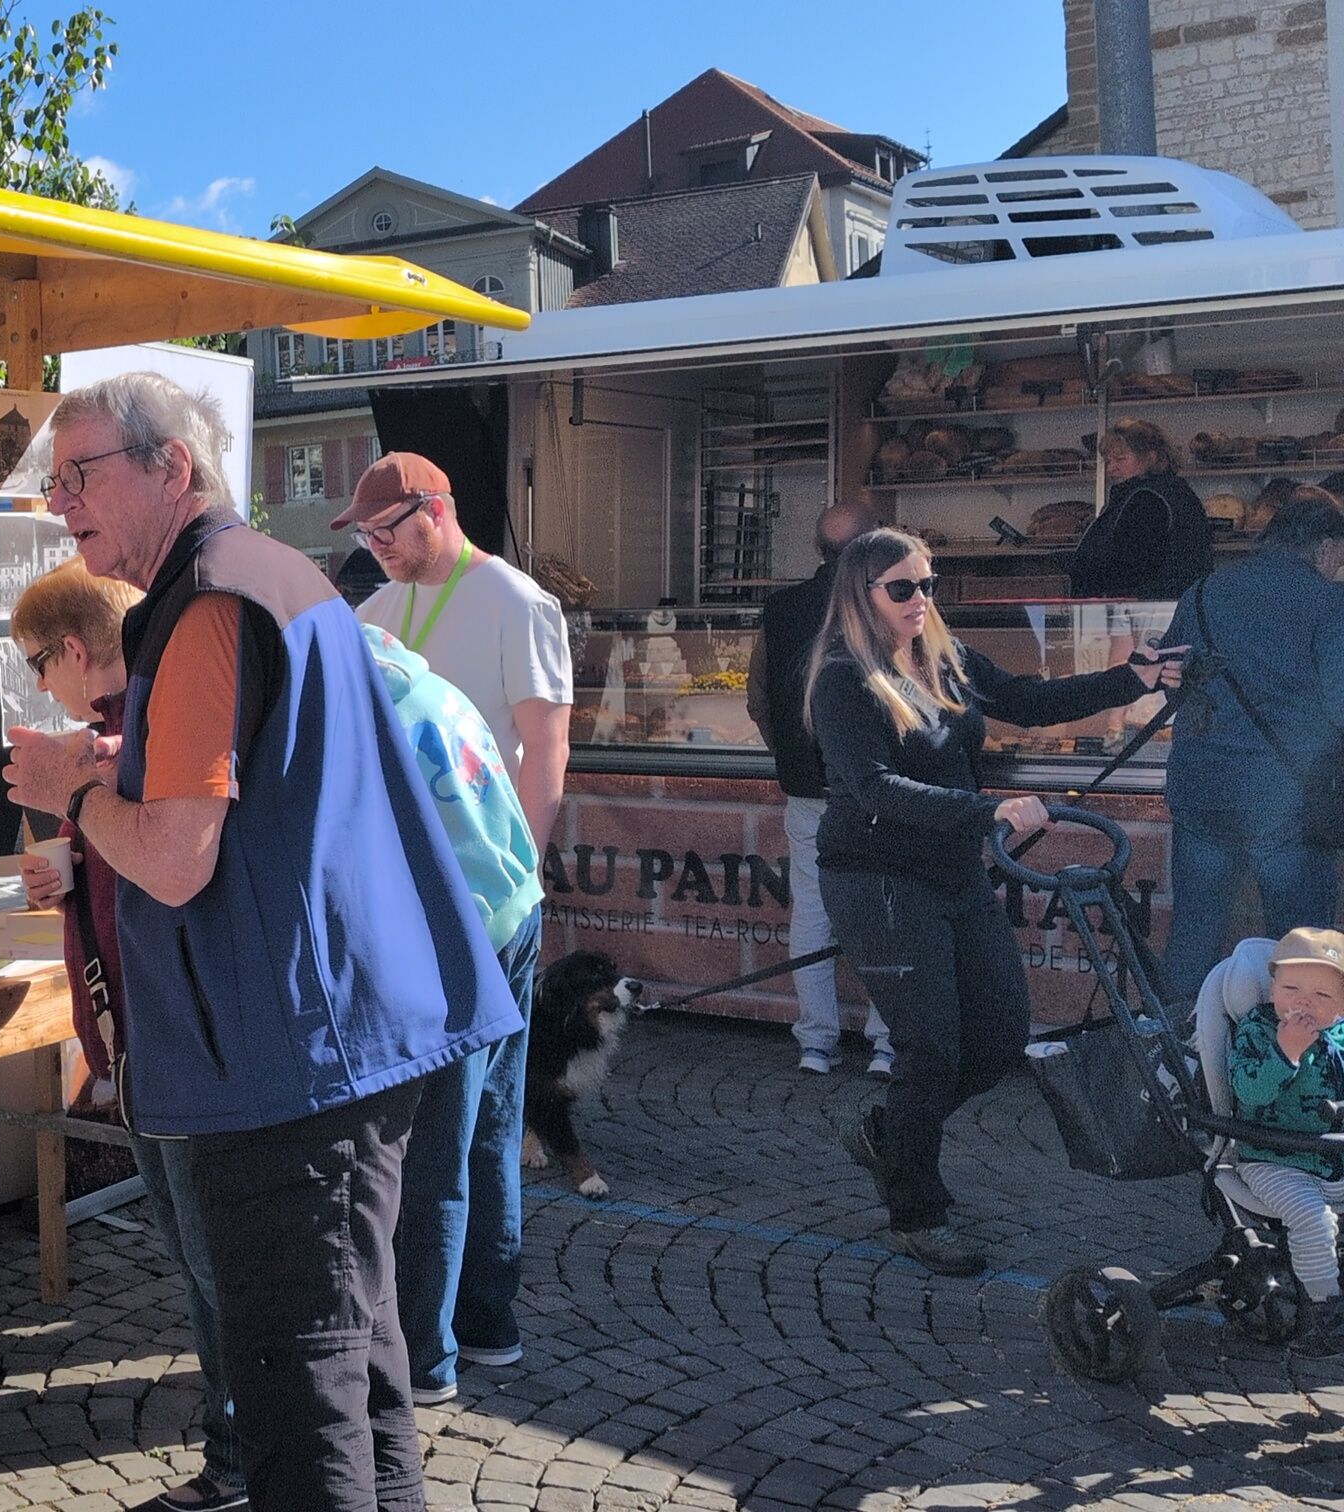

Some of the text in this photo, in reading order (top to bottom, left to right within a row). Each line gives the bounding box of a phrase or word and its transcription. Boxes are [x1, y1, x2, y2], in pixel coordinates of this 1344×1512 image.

[543, 842, 620, 897] AU
[635, 848, 791, 909] PAIN
[682, 914, 790, 947] TEA-ROO
[1028, 943, 1064, 971] DE
